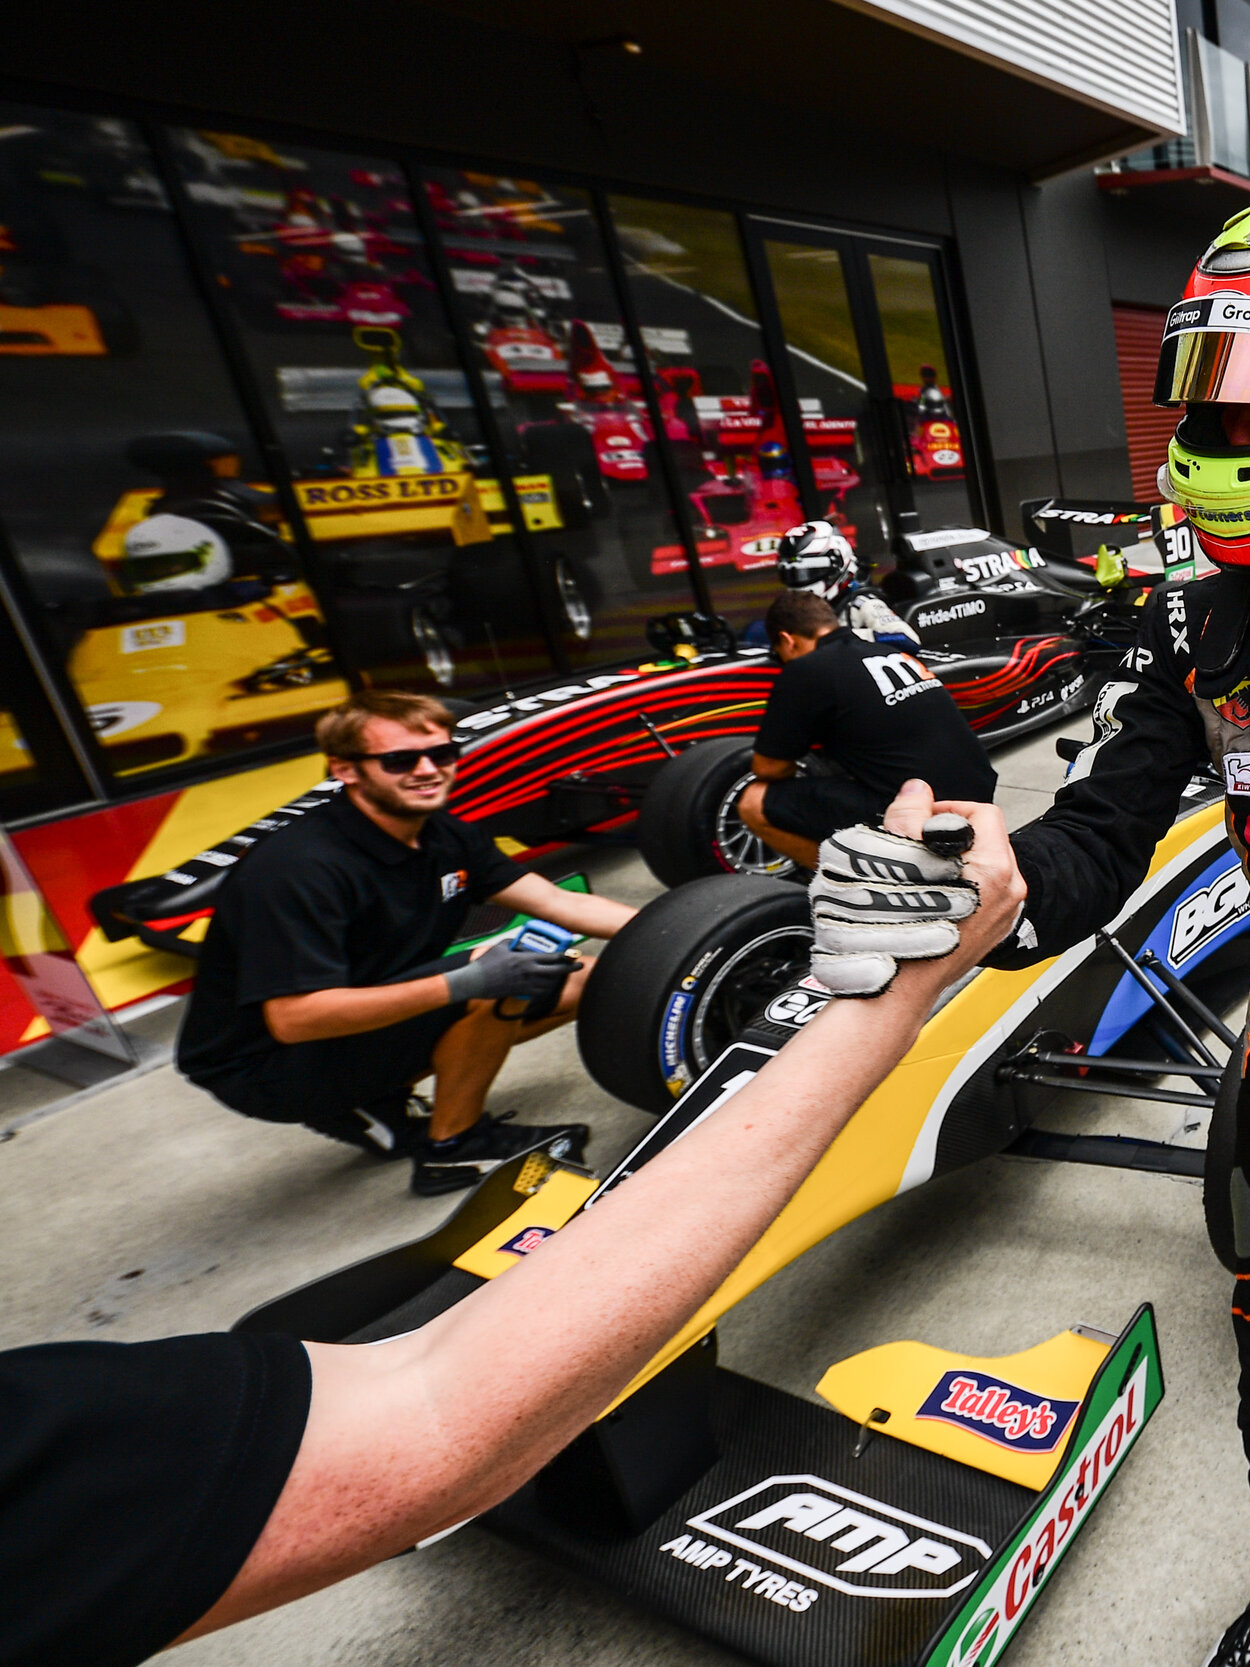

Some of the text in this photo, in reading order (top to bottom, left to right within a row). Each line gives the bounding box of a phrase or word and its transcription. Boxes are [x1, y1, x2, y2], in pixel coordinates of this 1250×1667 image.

[305, 478, 459, 505] ROSS LTD
[1163, 526, 1192, 565] 30
[1165, 589, 1191, 655] HRX
[1031, 690, 1055, 709] PS4
[663, 995, 687, 1067] MICHELIN
[940, 1375, 1057, 1438] Talley's
[734, 1492, 963, 1576] AMP
[1004, 1382, 1138, 1622] Castrol
[658, 1533, 820, 1613] AMP TYRES
